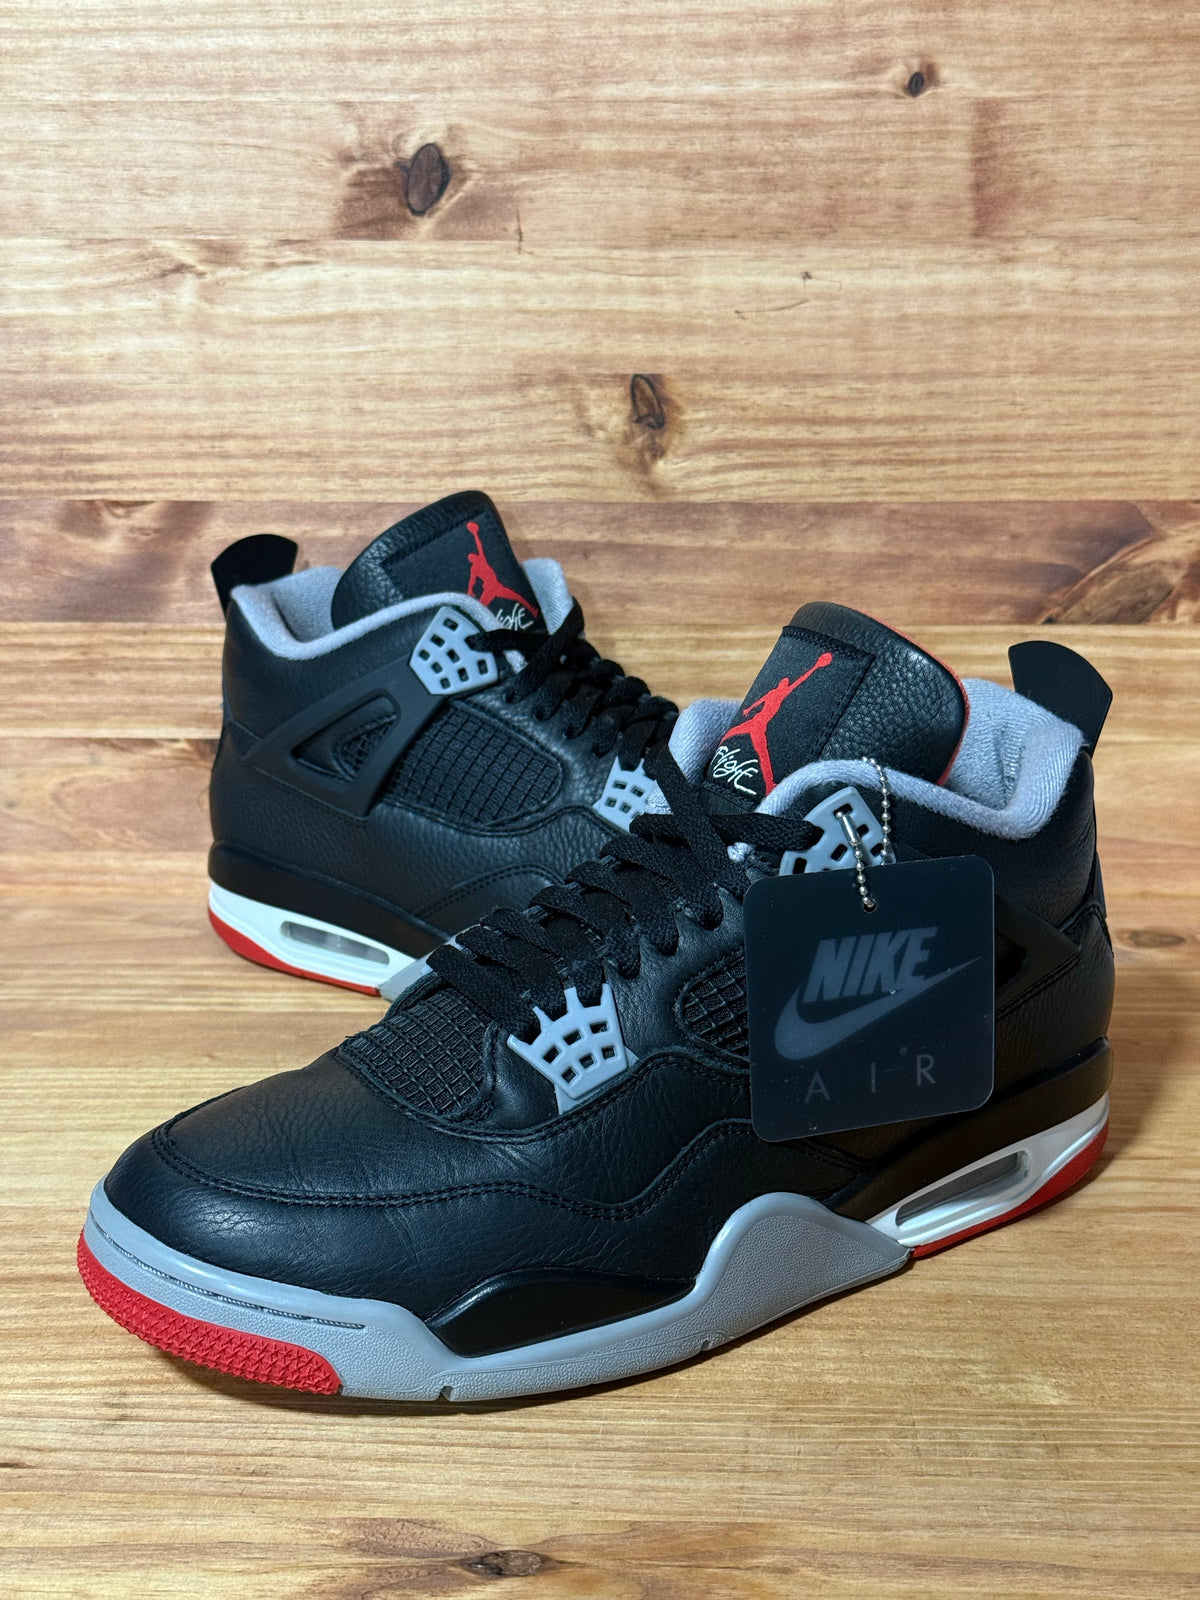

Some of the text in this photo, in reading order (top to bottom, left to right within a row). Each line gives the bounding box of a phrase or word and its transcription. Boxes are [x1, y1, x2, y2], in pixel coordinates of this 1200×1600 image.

[709, 746, 759, 795] Flight
[802, 926, 938, 1004] NIKE
[805, 1054, 937, 1104] AIR
